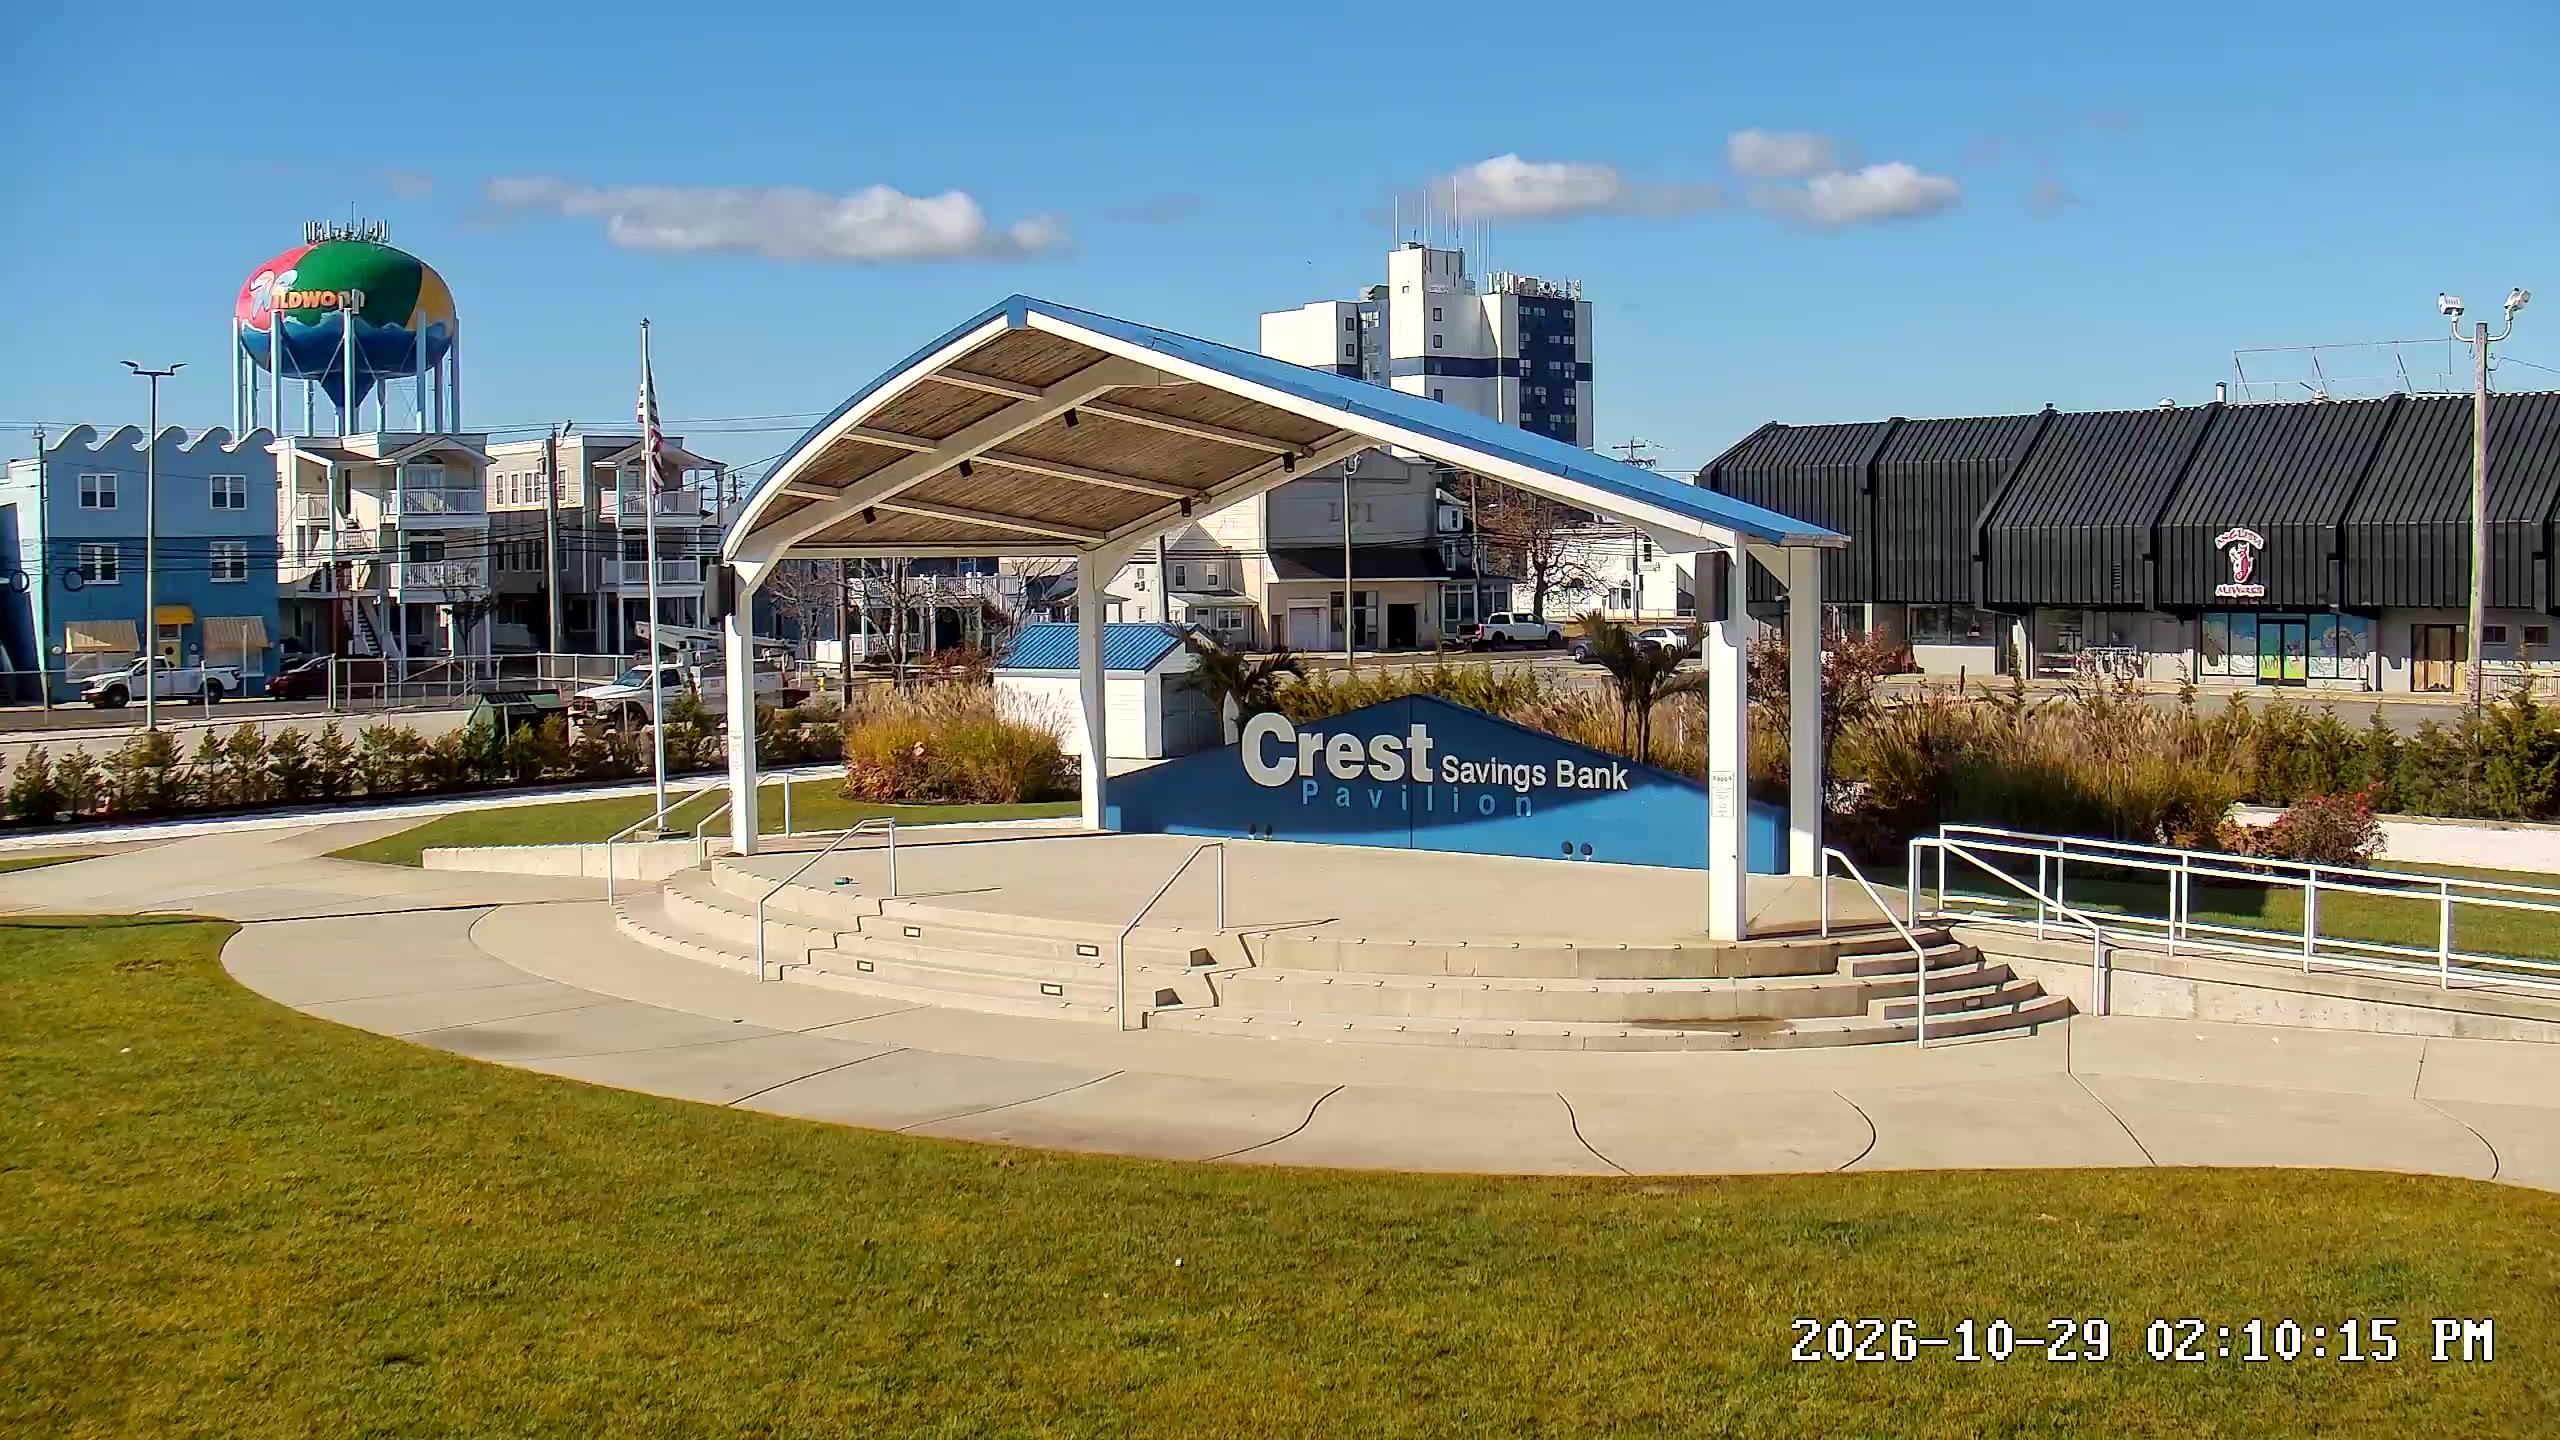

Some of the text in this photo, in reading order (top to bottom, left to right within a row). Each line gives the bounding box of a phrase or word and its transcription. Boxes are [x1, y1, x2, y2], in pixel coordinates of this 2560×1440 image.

[249, 269, 365, 319] WILDWO
[1241, 712, 1629, 793] Crest Savings Bank
[1302, 778, 1533, 817] Pavilion
